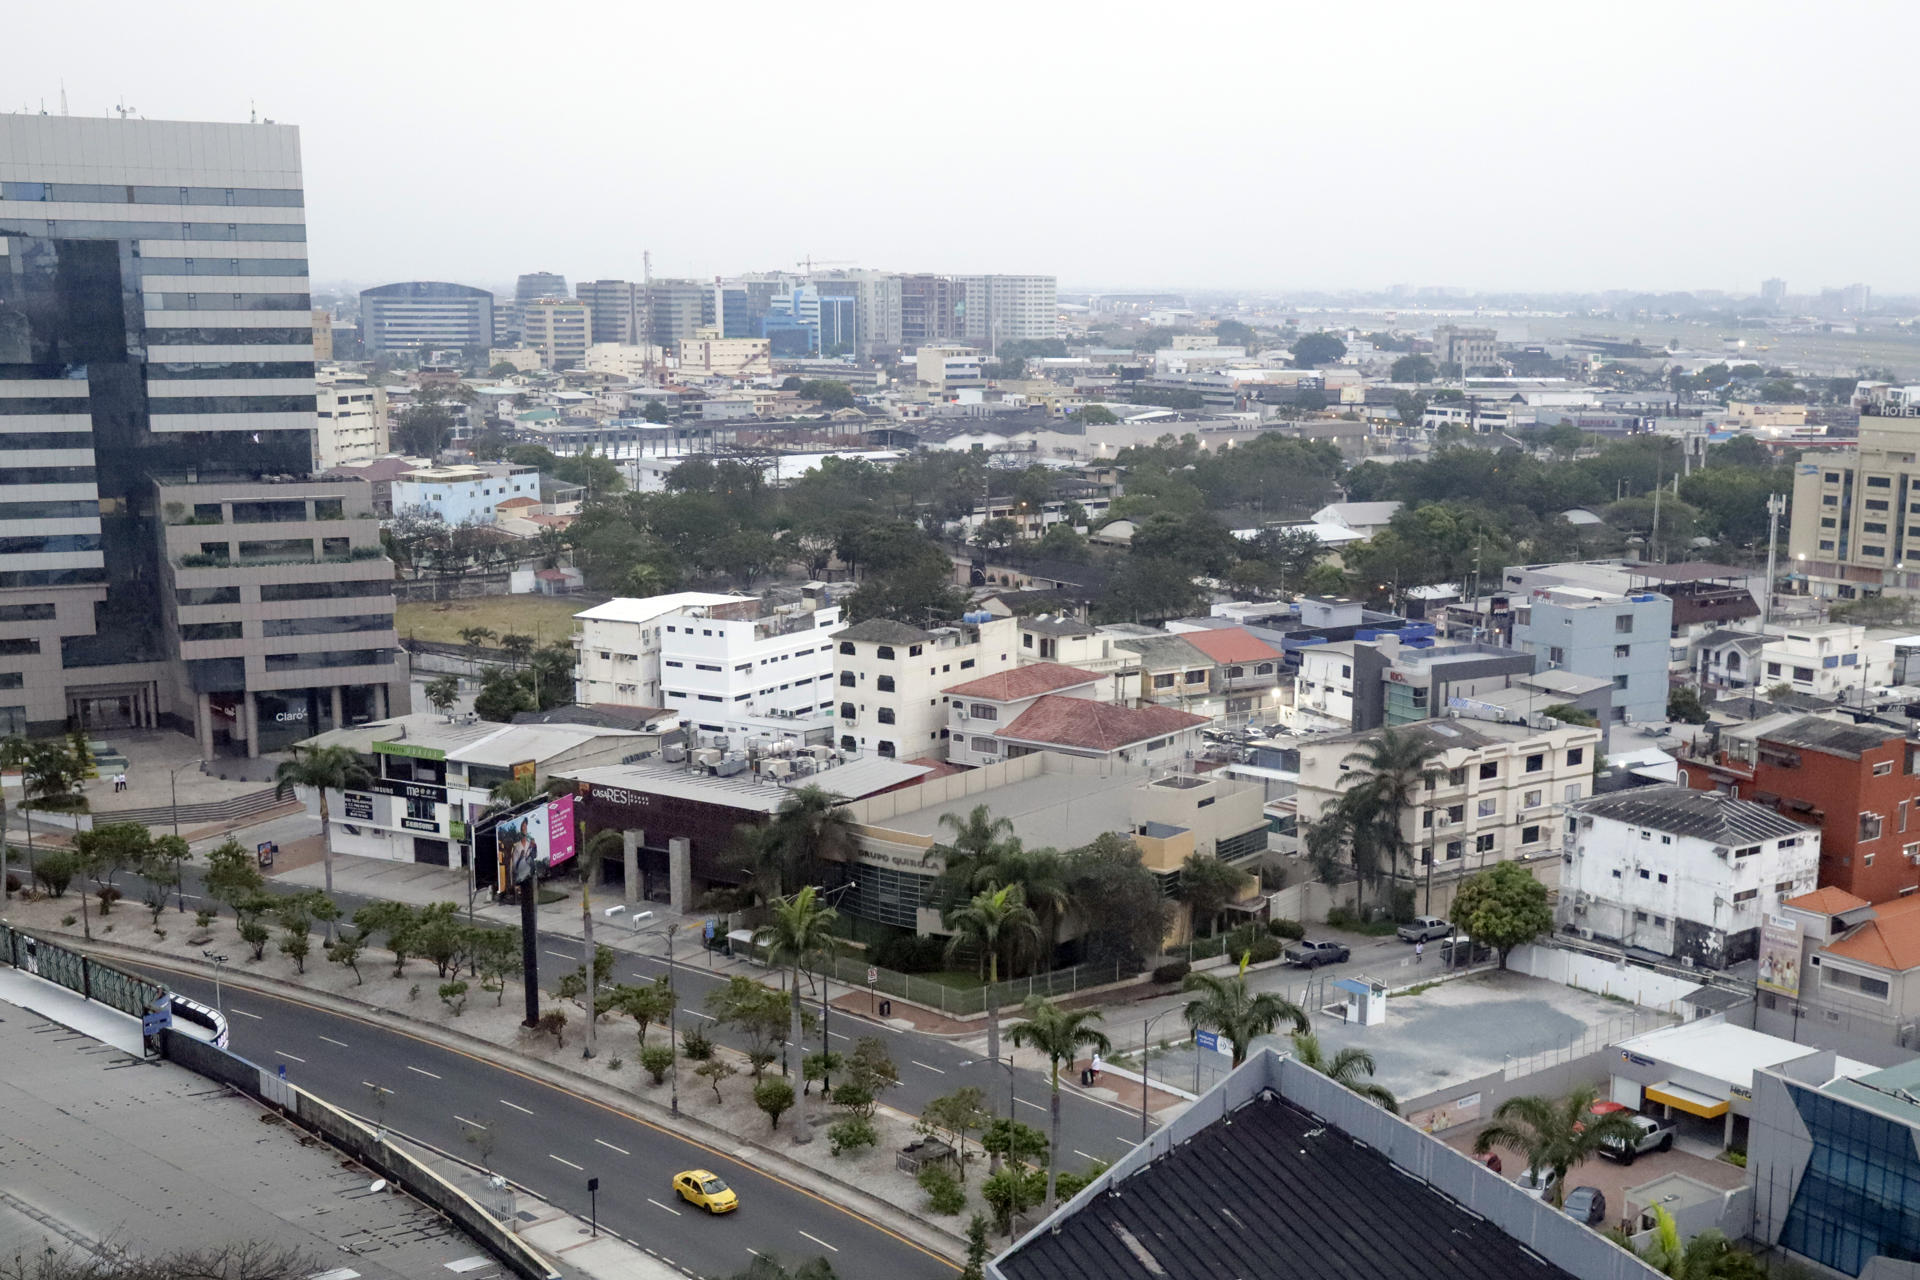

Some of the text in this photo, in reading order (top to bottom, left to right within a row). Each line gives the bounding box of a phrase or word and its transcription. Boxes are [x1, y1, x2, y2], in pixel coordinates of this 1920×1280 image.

[1880, 405, 1920, 417] HOTEL
[276, 711, 304, 722] Claro
[405, 821, 435, 831] SAMSUNG
[858, 849, 889, 862] GRUPO
